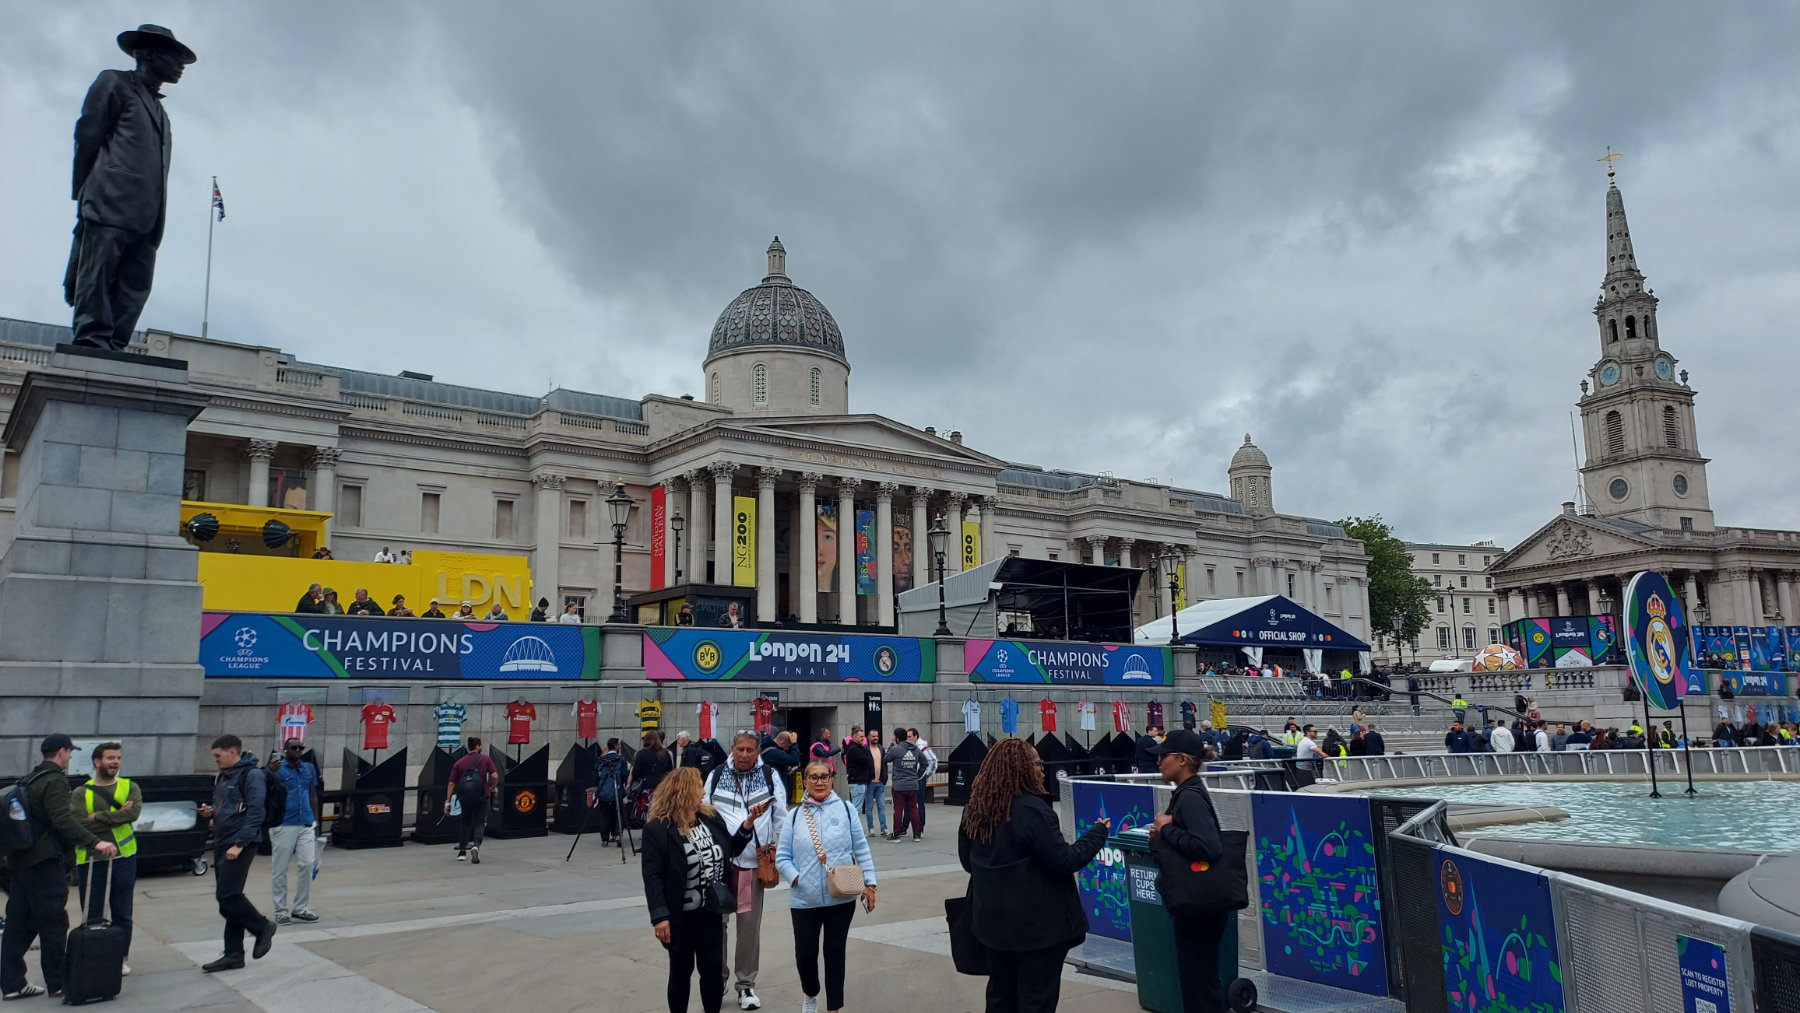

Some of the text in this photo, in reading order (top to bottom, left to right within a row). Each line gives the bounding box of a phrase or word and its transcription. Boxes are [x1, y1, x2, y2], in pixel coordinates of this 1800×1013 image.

[737, 512, 747, 568] NG200
[438, 572, 522, 608] LDN
[302, 629, 474, 655] CHAMPIONS
[1258, 630, 1307, 641] OFFICIAL SHOP
[220, 656, 269, 664] CHAMPIONS
[826, 644, 850, 663] 24
[1028, 649, 1109, 668] CHAMPIONS
[345, 657, 435, 672] FESTIVAL
[772, 666, 828, 676] FINAL
[1048, 669, 1092, 680] FESTIVAL
[1135, 879, 1155, 891] CUPS
[1136, 889, 1157, 901] HERE
[1681, 967, 1726, 989] SCAN TO REGISTER
[1685, 977, 1723, 998] LOST PROPERTY
